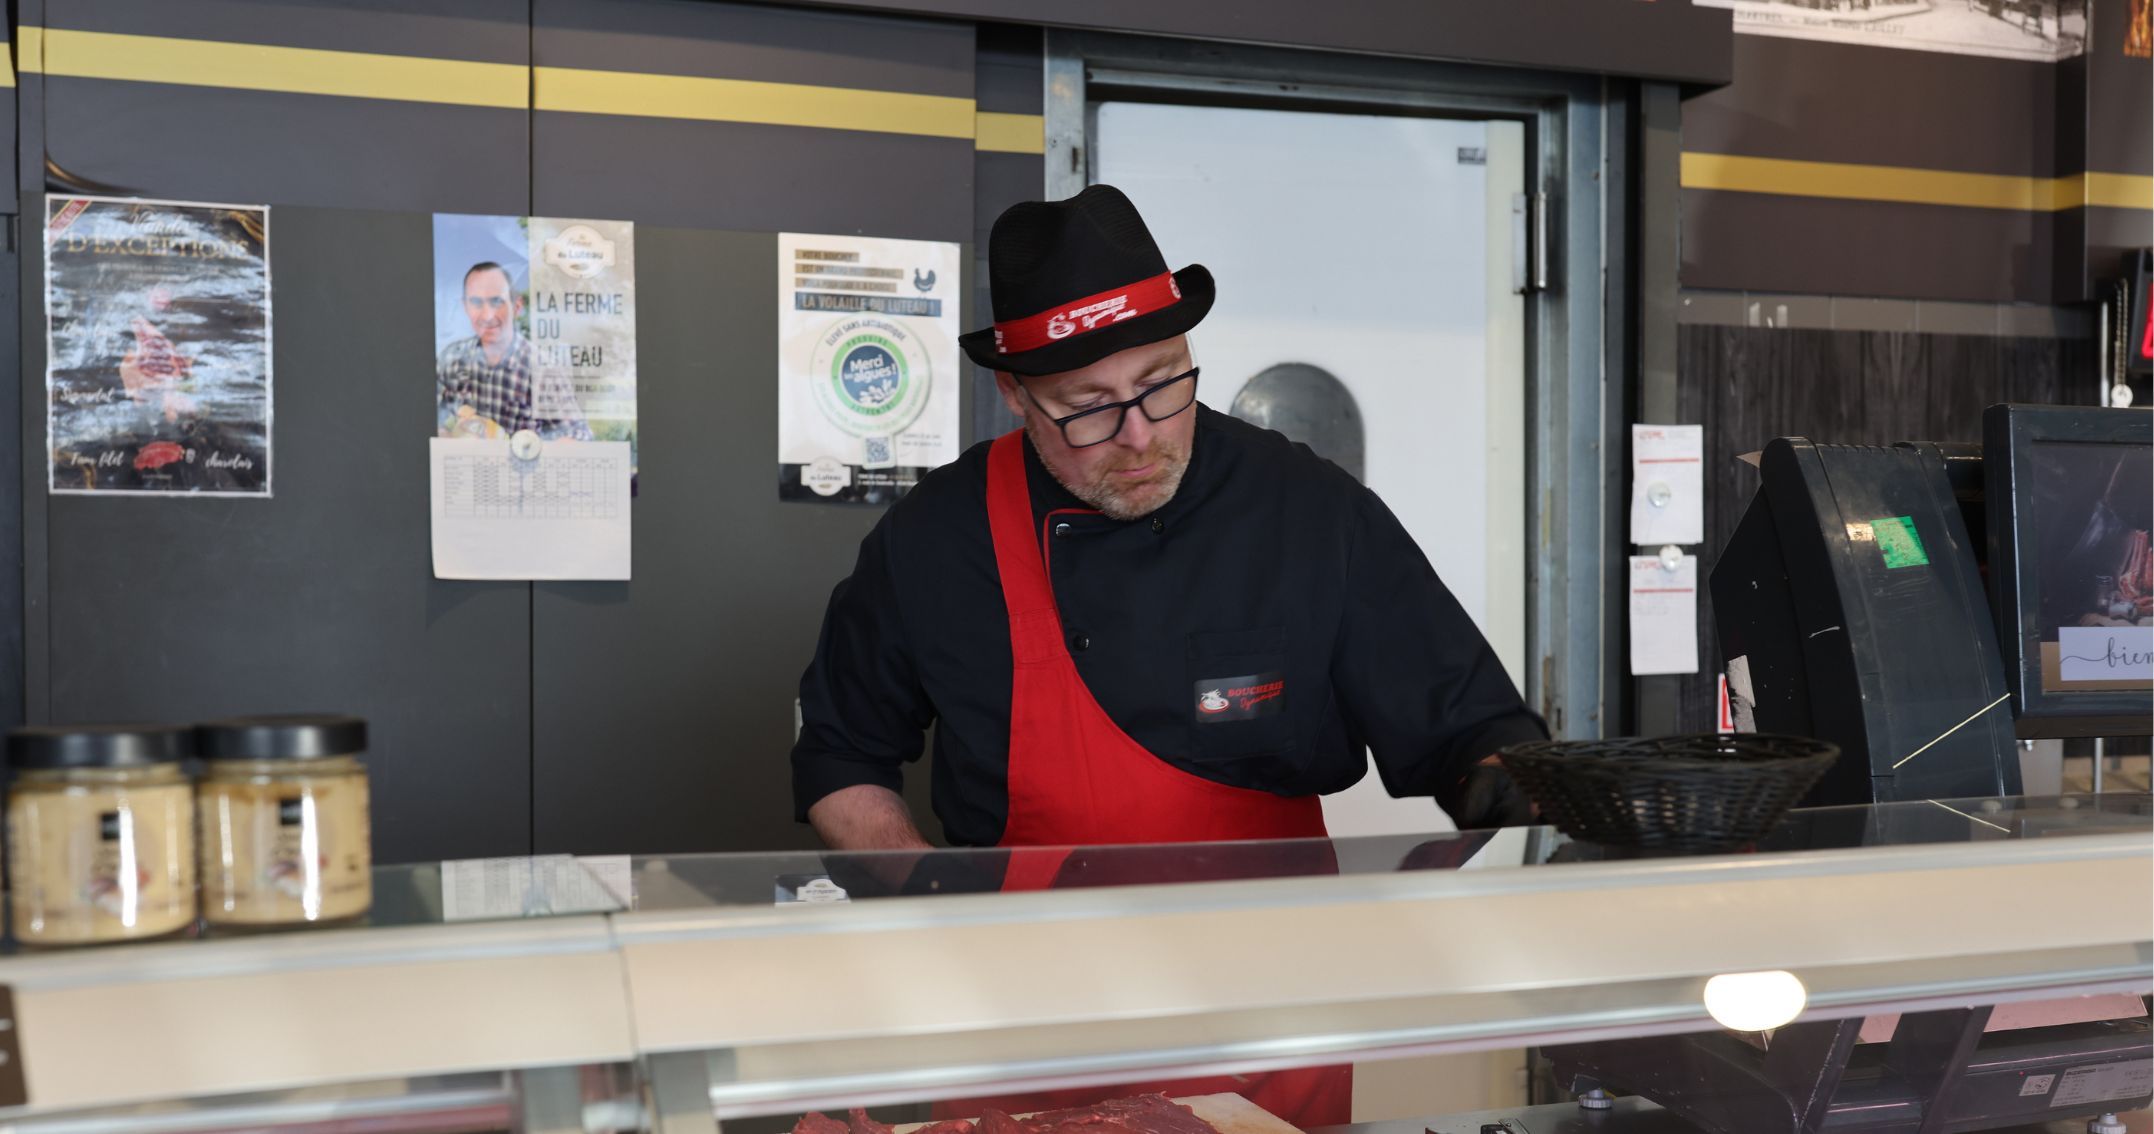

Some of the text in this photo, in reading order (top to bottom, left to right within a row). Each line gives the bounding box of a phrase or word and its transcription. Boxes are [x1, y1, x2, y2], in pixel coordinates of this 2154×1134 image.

[68, 233, 249, 260] D'EXCEPTIONS
[536, 291, 624, 315] LA FERME
[802, 295, 817, 308] LA
[820, 296, 865, 310] VOLAILLE
[888, 299, 928, 313] LUTEAU
[537, 318, 560, 340] DU
[537, 345, 602, 367] LUTEAU
[850, 353, 884, 373] Merci
[1228, 681, 1284, 697] BOUCHERIE
